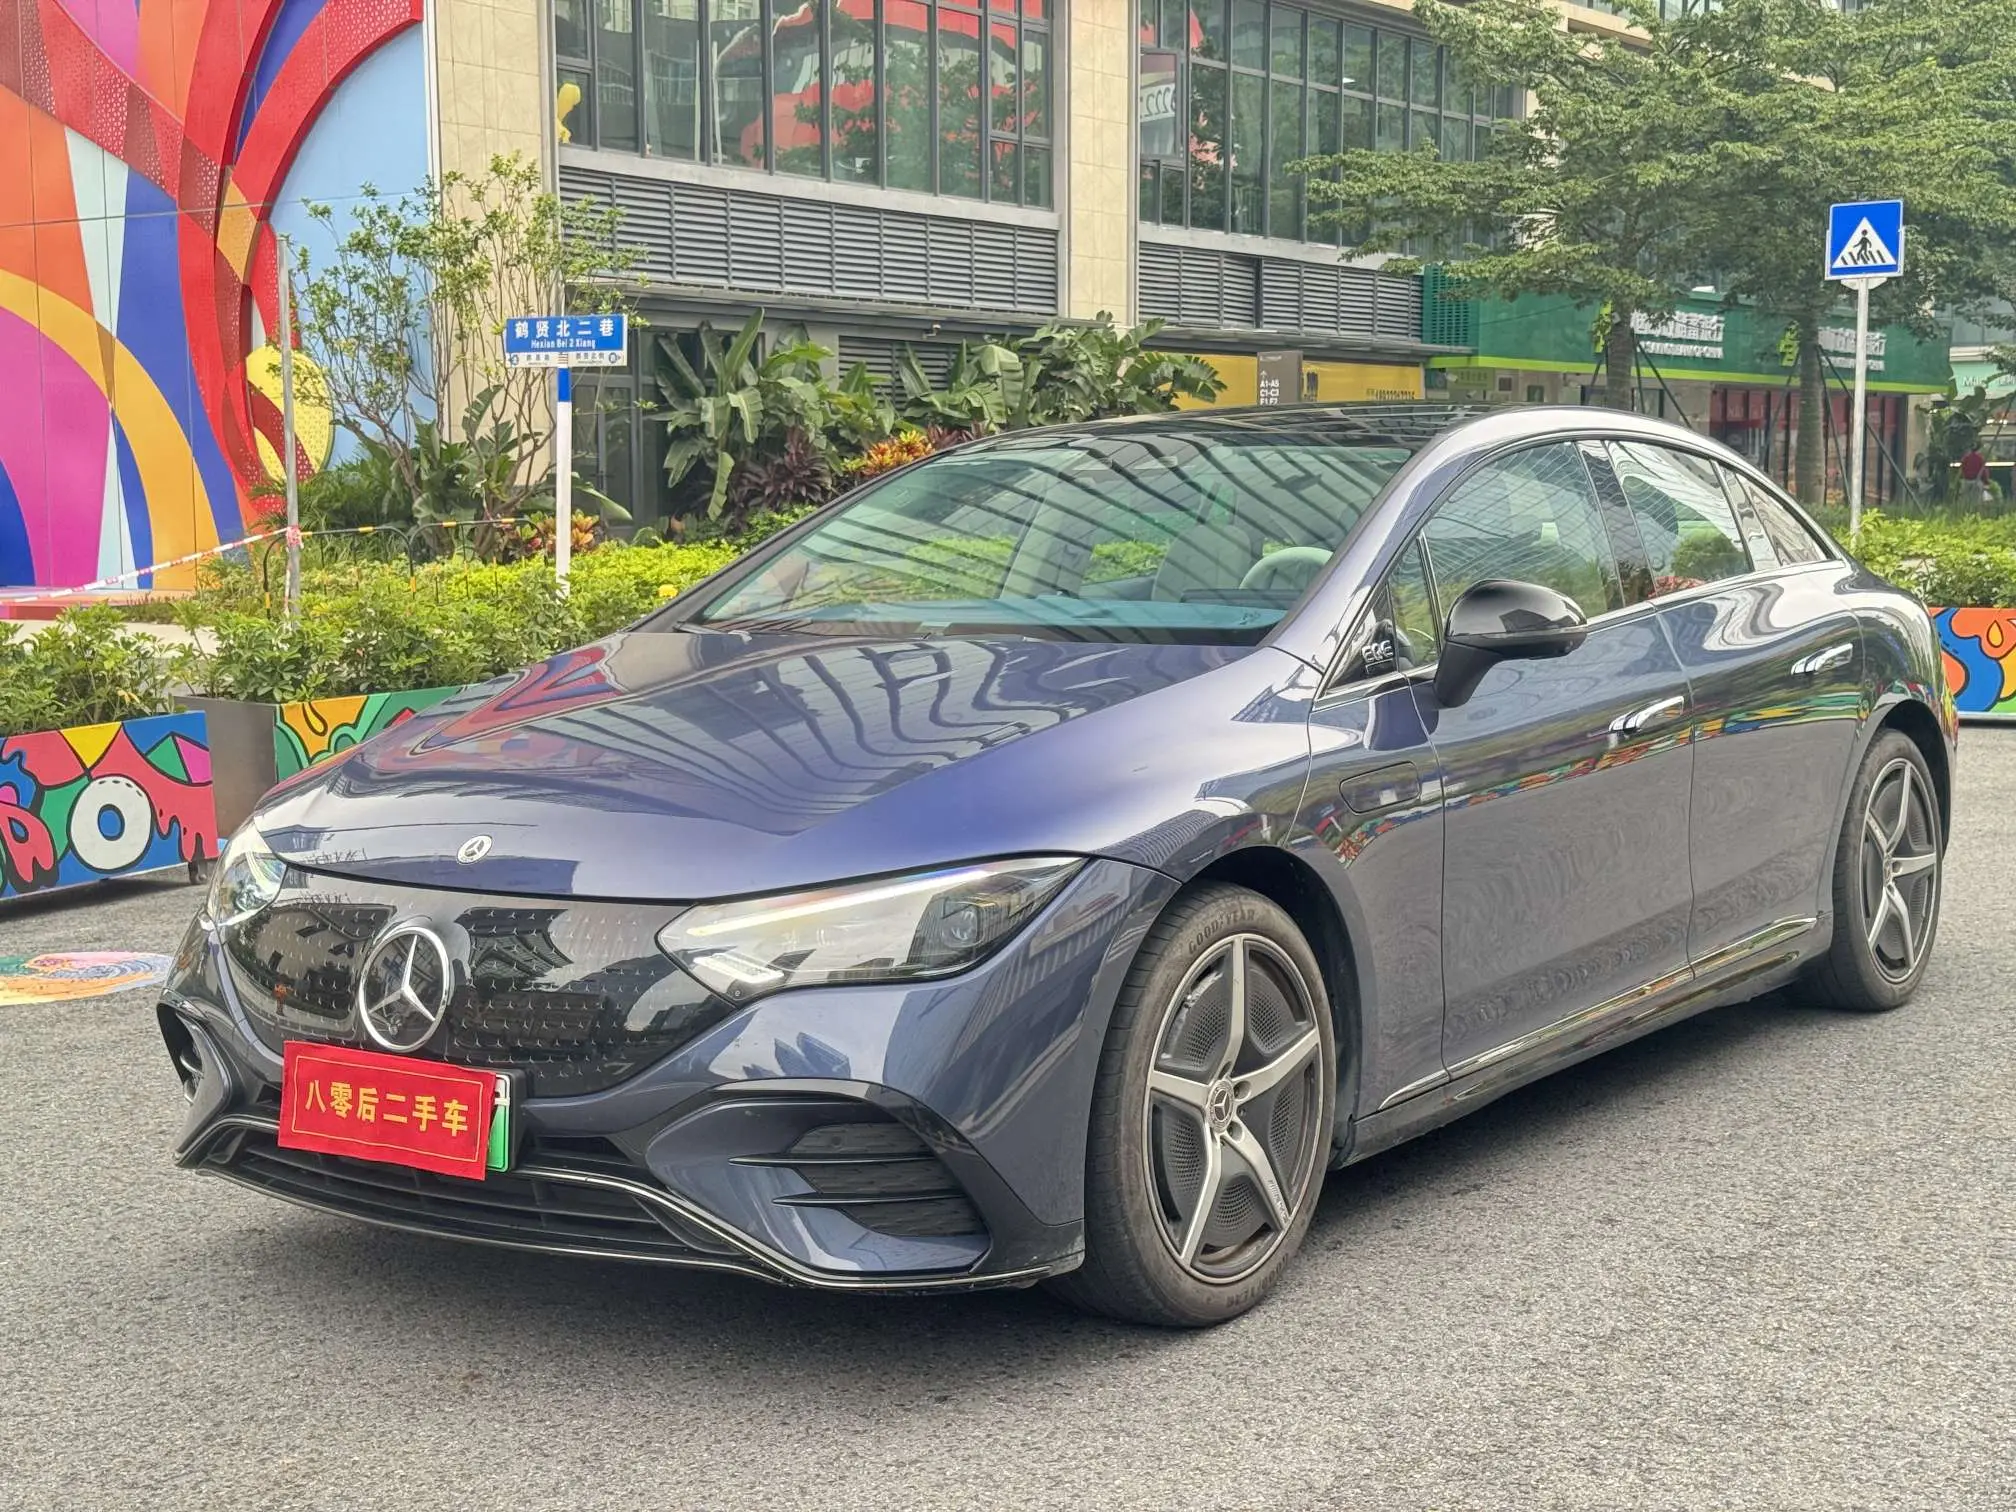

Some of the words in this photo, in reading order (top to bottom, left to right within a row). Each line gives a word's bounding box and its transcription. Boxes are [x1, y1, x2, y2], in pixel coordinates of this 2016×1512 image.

[515, 319, 614, 338] 鹤贤北二巷
[531, 339, 555, 349] Hexian
[556, 339, 568, 348] Bei
[569, 339, 574, 348] 2
[575, 339, 596, 350] Xiang
[1362, 640, 1393, 663] EQE
[305, 1080, 468, 1137] 八零后二手车
